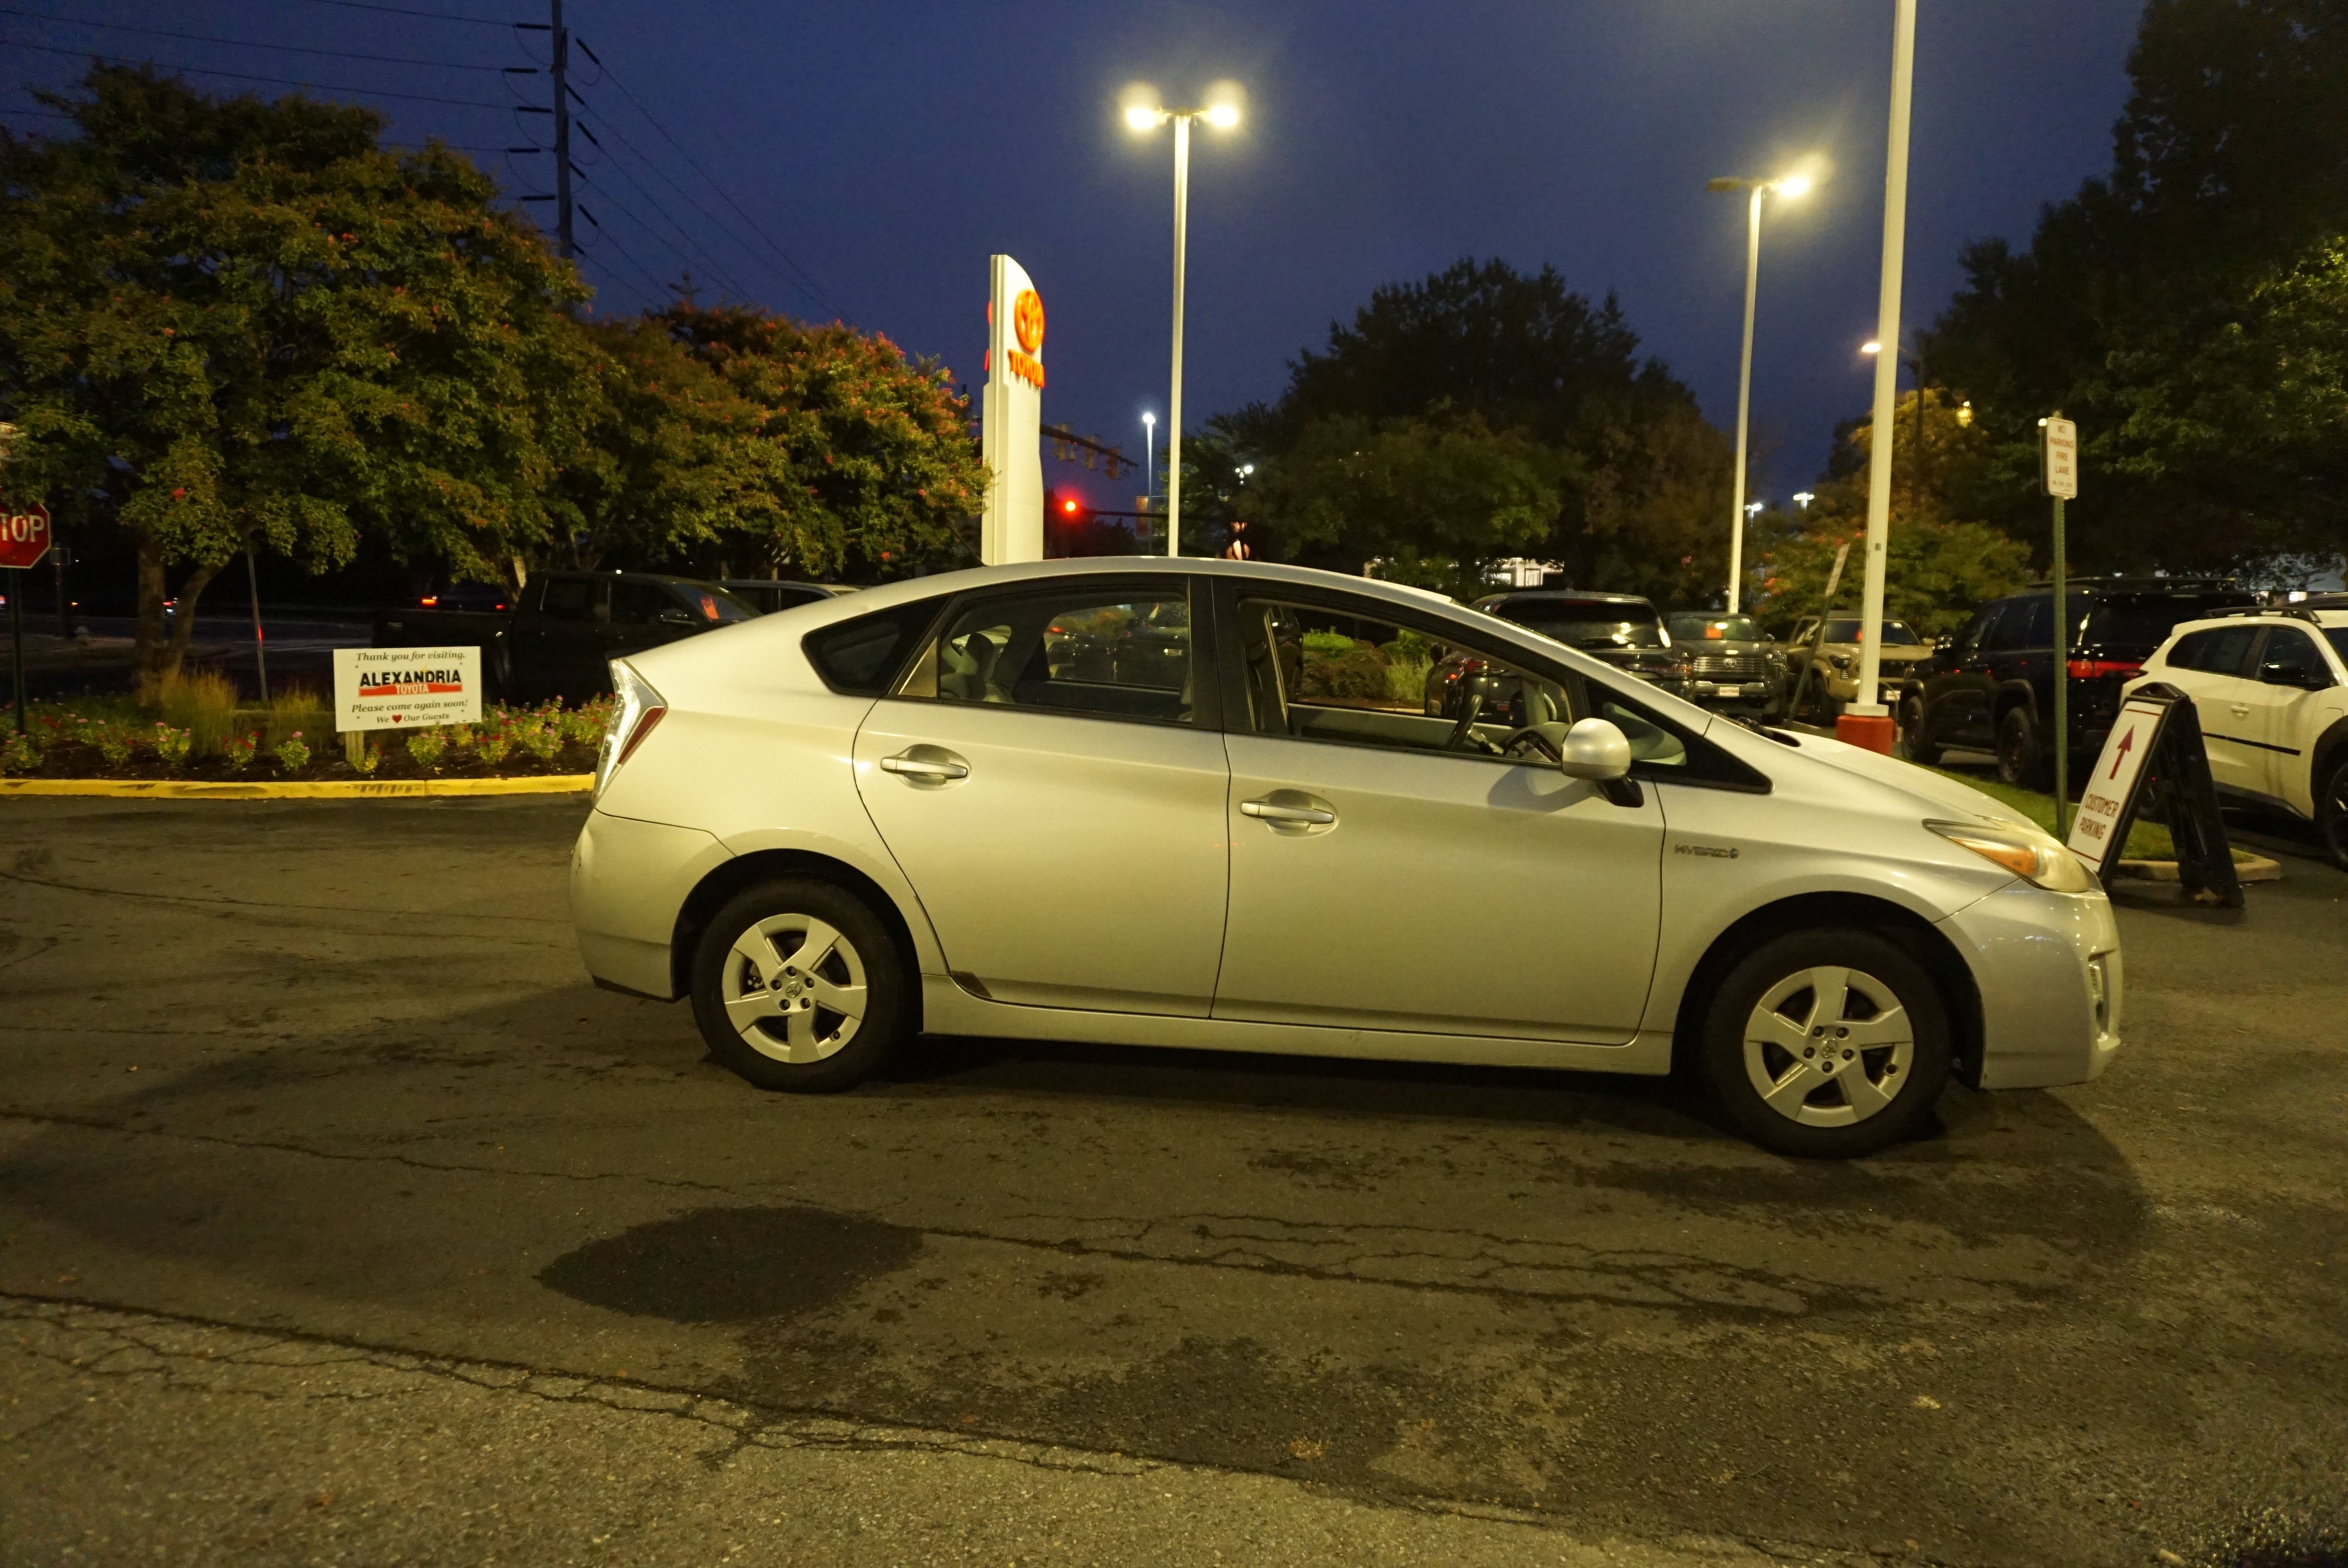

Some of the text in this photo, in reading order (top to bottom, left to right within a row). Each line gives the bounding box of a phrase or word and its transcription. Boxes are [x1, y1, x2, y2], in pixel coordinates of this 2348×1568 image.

[2050, 437, 2074, 449] PARKING
[2056, 451, 2068, 461] FIRE
[2055, 466, 2069, 475] LANE
[0, 512, 44, 542] TOP
[357, 652, 388, 661] Thank
[410, 651, 425, 662] for
[428, 651, 465, 660] visiting.
[360, 669, 461, 687] ALEXANDRIA
[395, 684, 429, 695] TOYOTA
[352, 704, 384, 713] Please
[414, 700, 441, 710] again
[443, 699, 468, 708] soon!
[2085, 793, 2119, 818] CUSTOMER
[2080, 817, 2106, 839] PARKING
